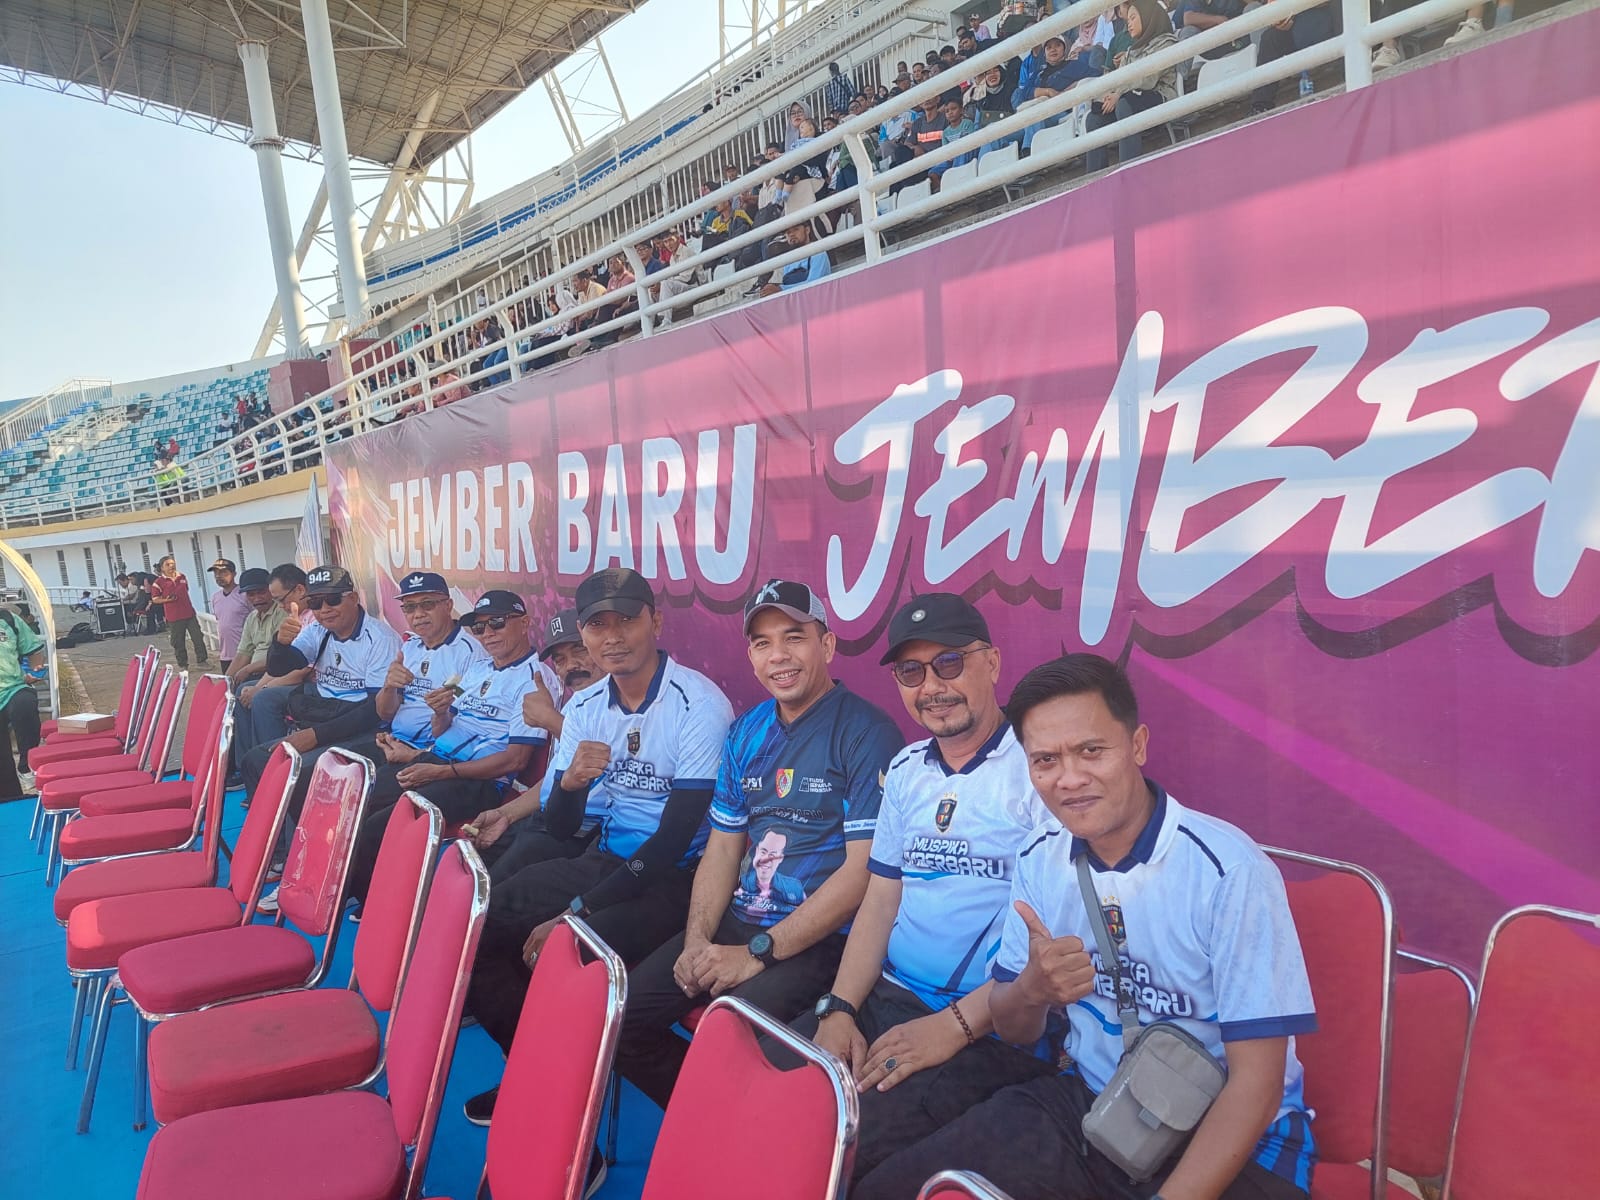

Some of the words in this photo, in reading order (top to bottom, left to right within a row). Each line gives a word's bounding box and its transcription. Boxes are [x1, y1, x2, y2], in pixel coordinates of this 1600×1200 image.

[389, 461, 538, 573] JEMBER
[557, 423, 757, 585] BARU
[308, 571, 331, 585] 942
[912, 837, 968, 856] MUSPIKA
